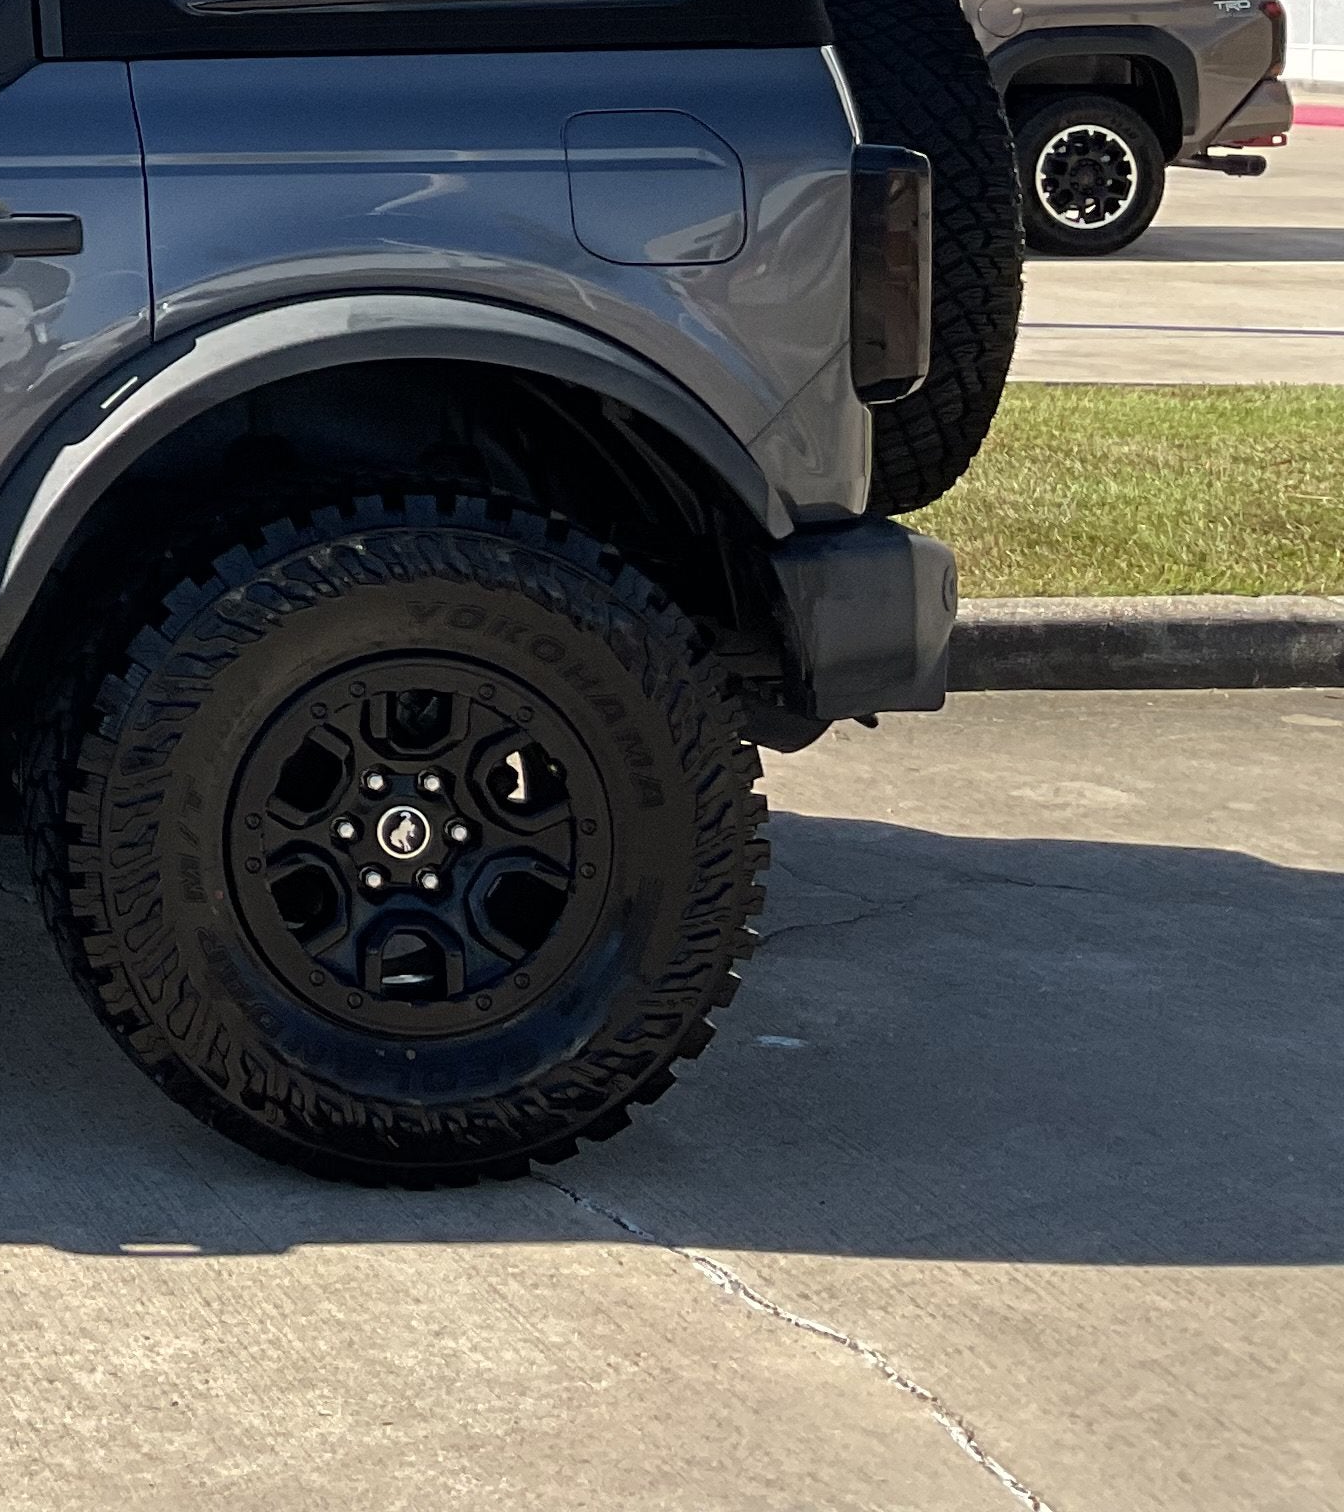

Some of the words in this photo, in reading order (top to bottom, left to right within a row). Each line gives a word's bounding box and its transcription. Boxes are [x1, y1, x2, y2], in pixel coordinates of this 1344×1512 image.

[1213, 0, 1251, 12] TRD
[406, 600, 665, 808] YOKOHAMA
[178, 774, 208, 903] M/T
